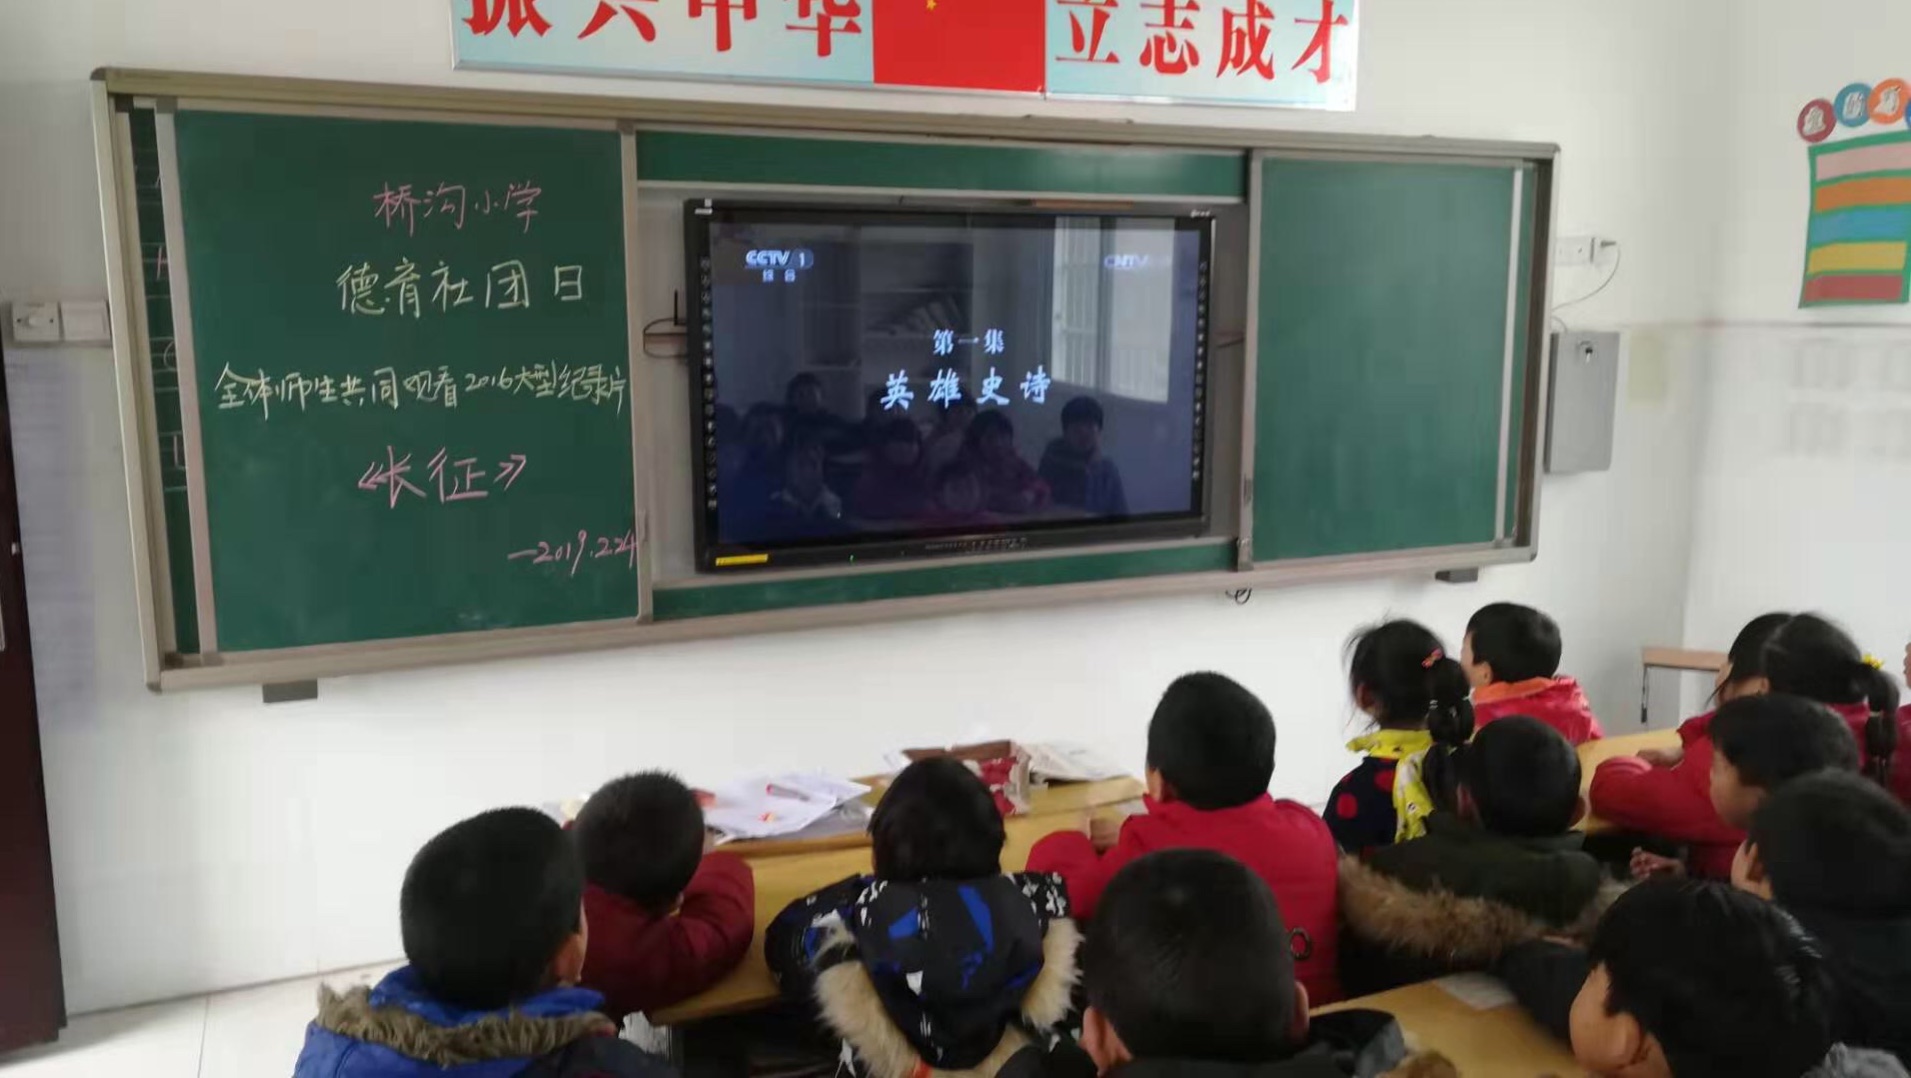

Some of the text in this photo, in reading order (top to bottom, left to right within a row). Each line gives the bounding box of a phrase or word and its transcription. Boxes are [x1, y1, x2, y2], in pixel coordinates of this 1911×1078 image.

[1054, 0, 1349, 84] 立志成才
[373, 181, 542, 237] 桥沟小学
[745, 249, 791, 267] CCTV
[336, 257, 583, 318] 德育社团日
[932, 328, 1005, 356] 第一集
[880, 364, 1051, 411] 英雄史诗
